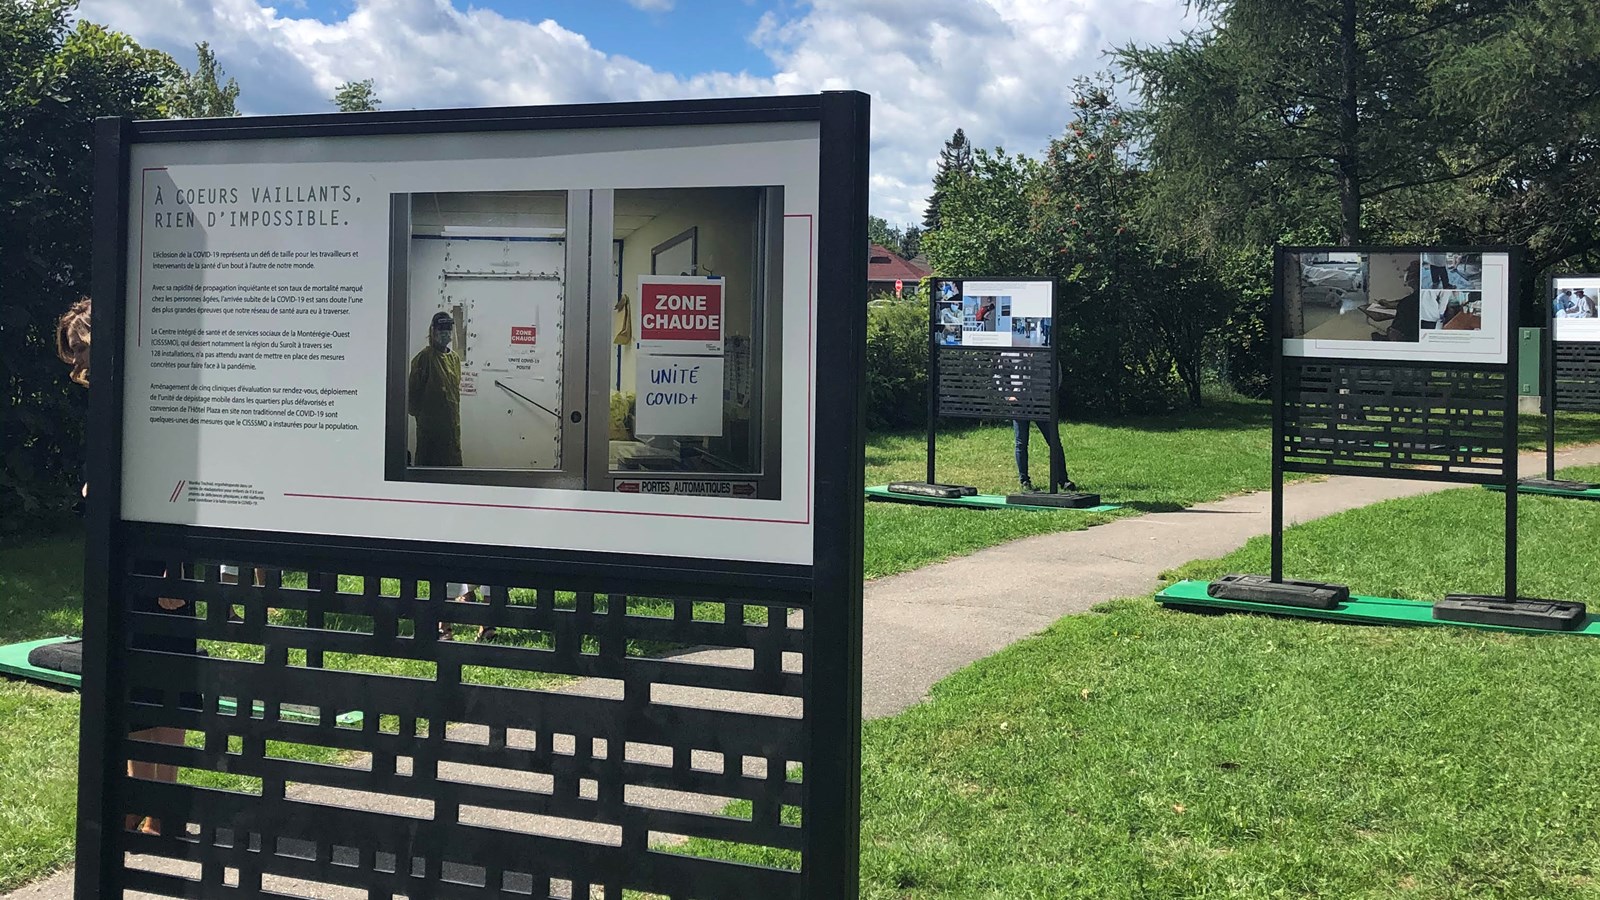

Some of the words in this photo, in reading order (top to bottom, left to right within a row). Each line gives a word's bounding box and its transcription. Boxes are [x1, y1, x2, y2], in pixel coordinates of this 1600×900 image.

[155, 186, 163, 204] À
[176, 188, 238, 204] COEURS
[252, 186, 361, 203] VAILLANTS,
[155, 212, 194, 228] RIEN
[208, 210, 349, 227] D'IMPOSSIBLE.
[656, 295, 706, 310] ZONE
[643, 314, 719, 330] CHAUDE
[151, 384, 189, 392] Aménagement
[212, 385, 236, 393] cliniques
[320, 388, 358, 396] déploiement
[184, 395, 210, 403] dépistage
[255, 397, 280, 406] quartiers
[646, 392, 698, 406] COVID+
[642, 481, 670, 493] PORTES
[674, 482, 730, 494] AUTOMATIQUES
